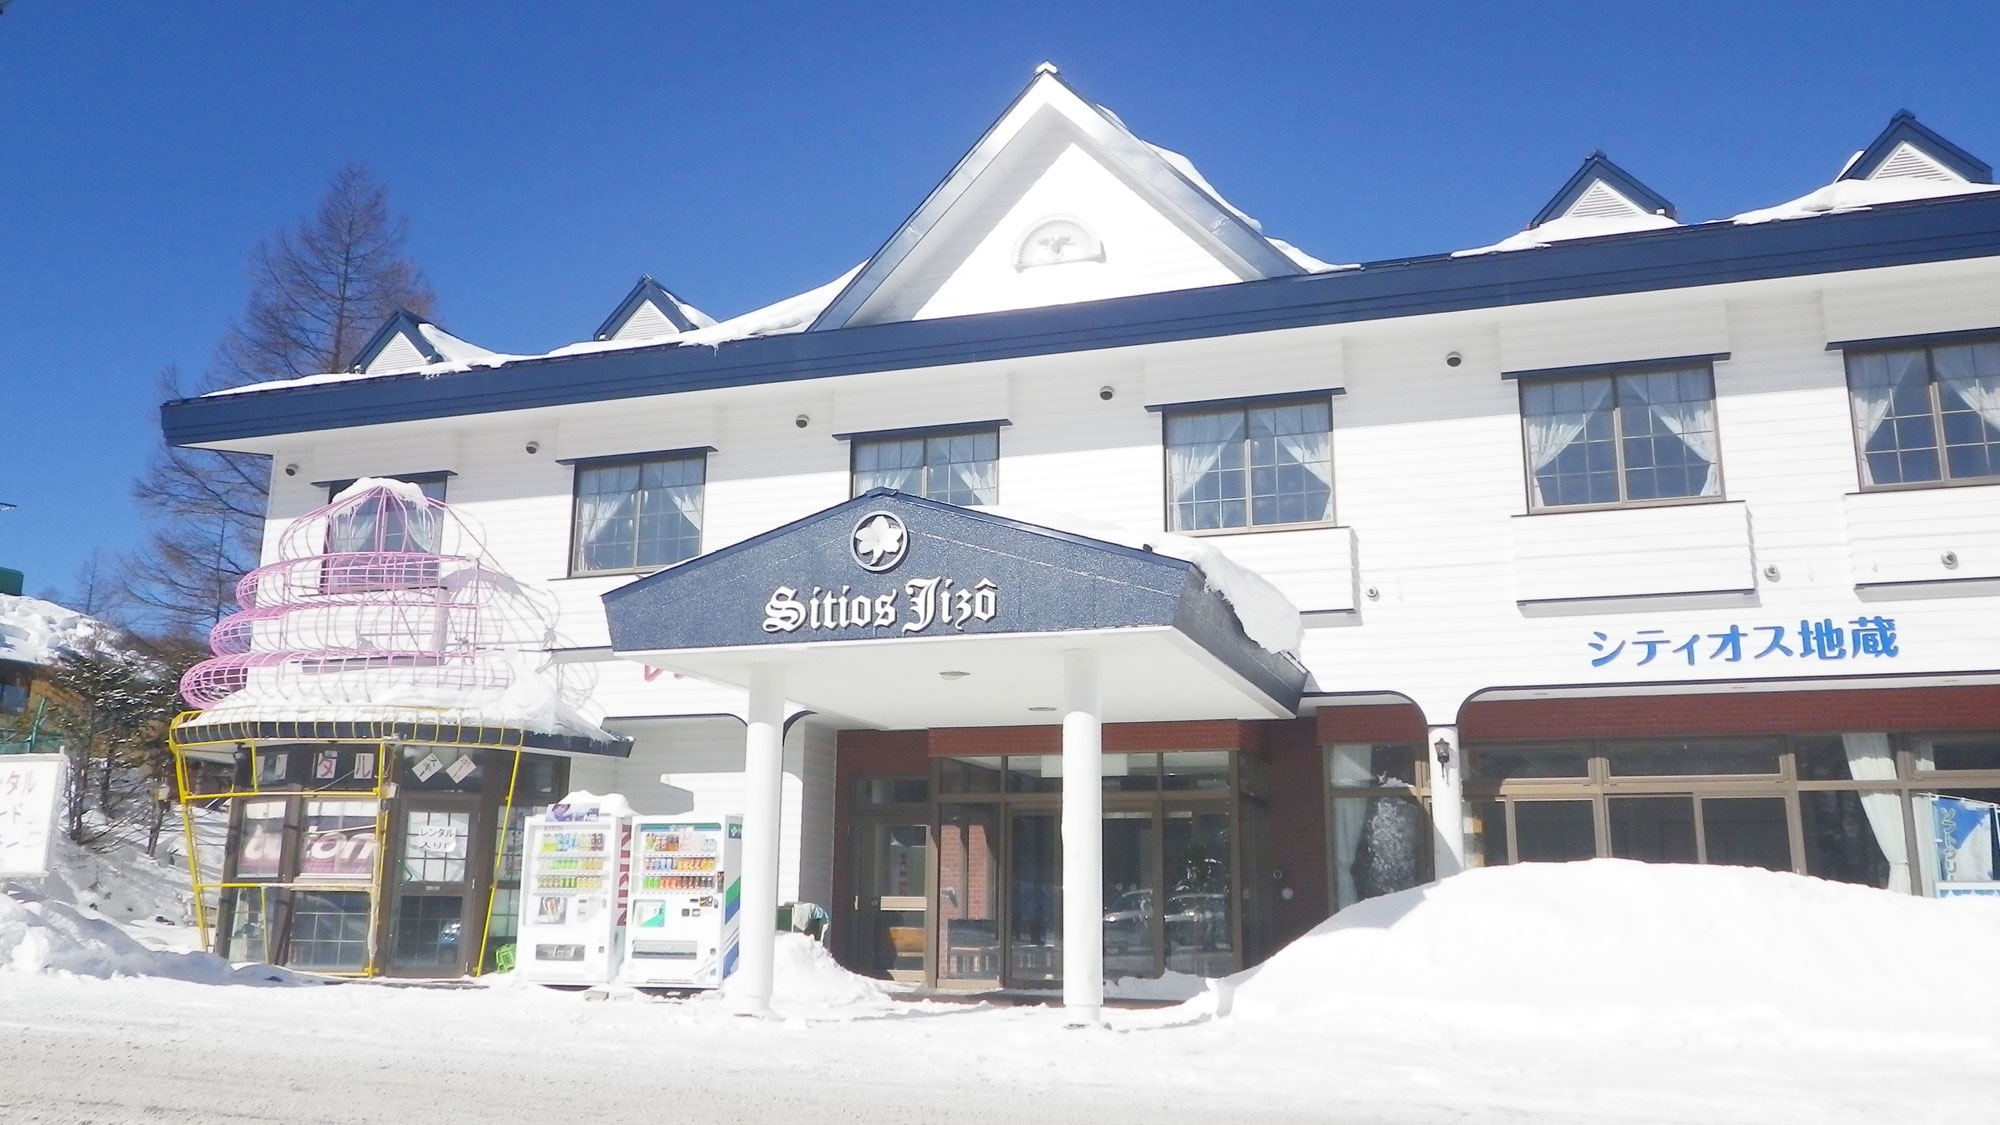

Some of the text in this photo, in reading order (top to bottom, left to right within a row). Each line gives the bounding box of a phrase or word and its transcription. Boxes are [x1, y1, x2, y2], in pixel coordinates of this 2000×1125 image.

[763, 576, 998, 635] Sitios Jizô
[1587, 616, 1899, 667] シティオス地蔵
[420, 828, 455, 838] レンタル
